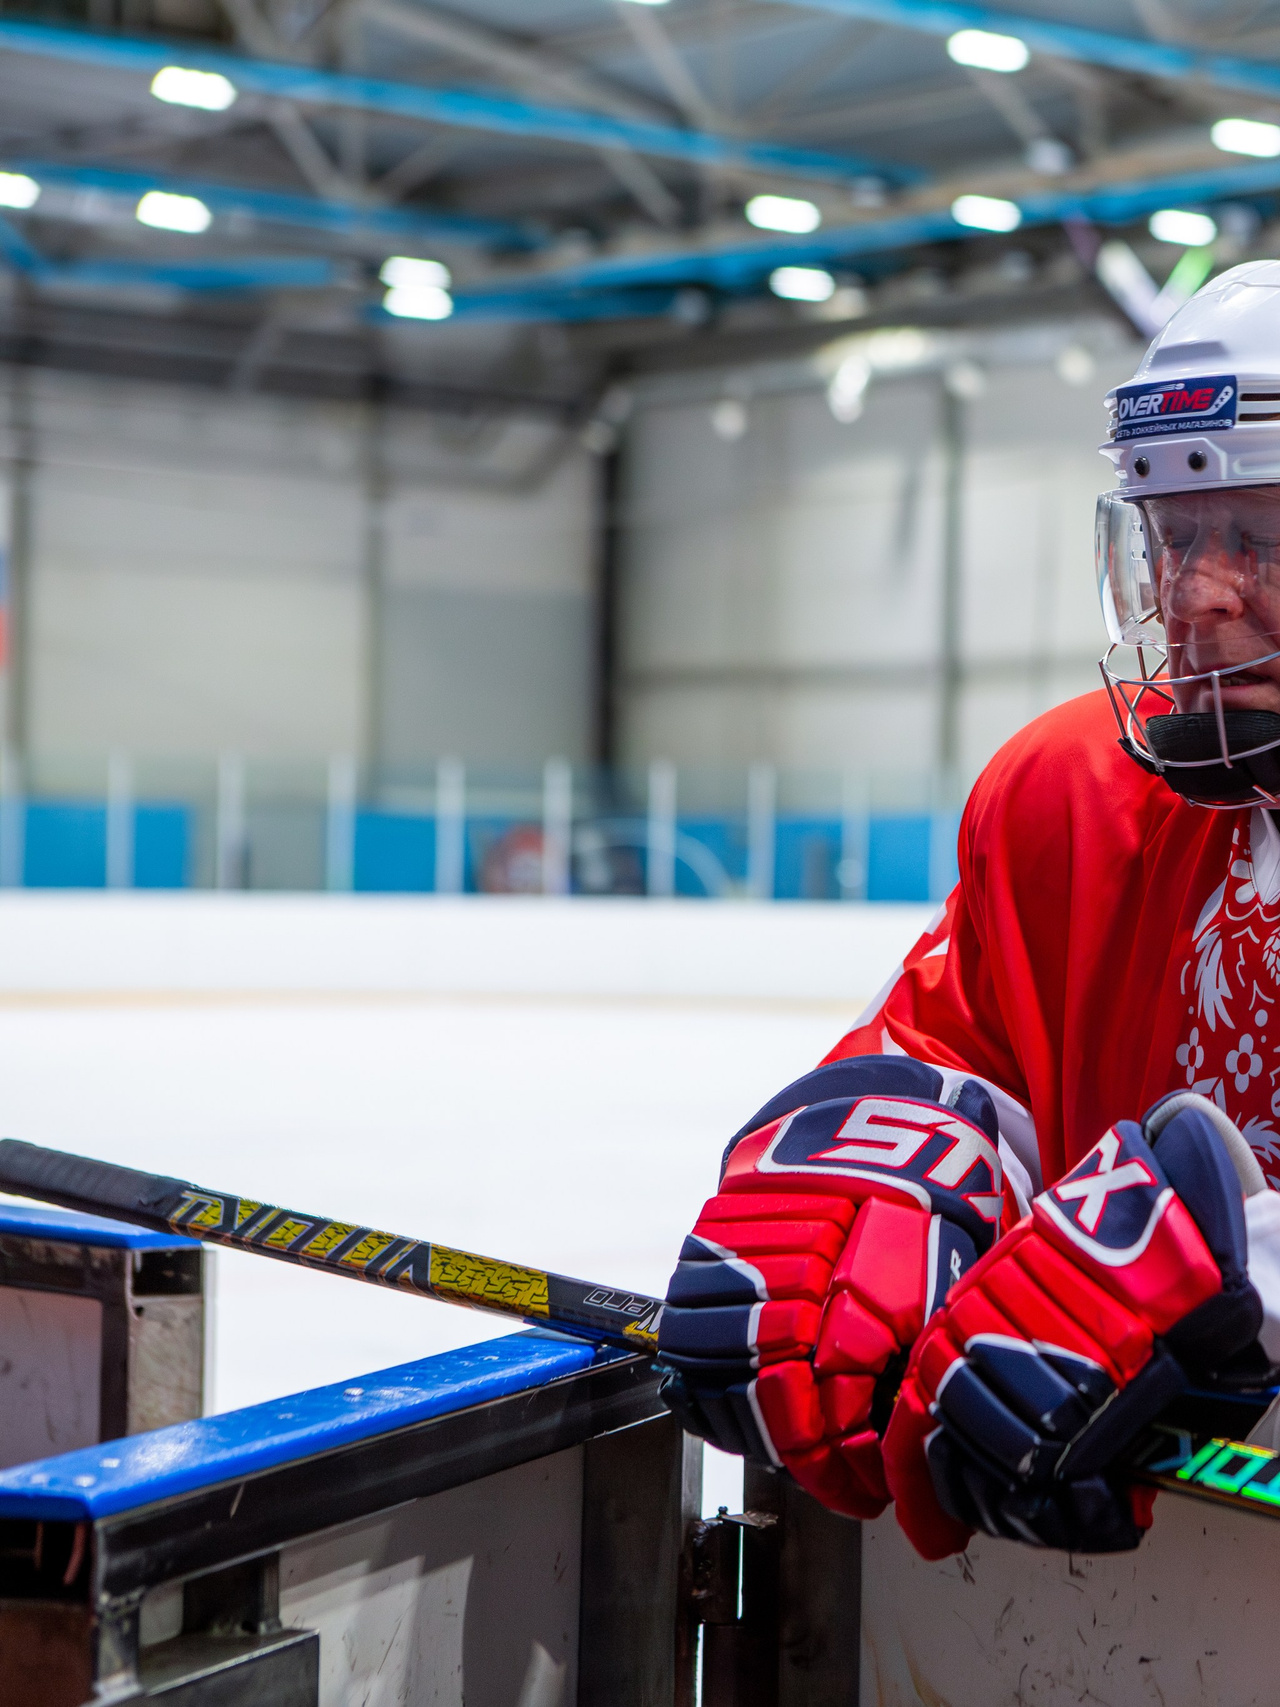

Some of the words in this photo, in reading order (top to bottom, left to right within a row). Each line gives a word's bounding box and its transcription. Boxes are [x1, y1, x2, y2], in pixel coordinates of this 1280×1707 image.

[1119, 388, 1215, 419] OVERTIME
[1131, 424, 1177, 436] ХОККЕЙНЫХ
[1178, 419, 1233, 430] МАГАЗИНОВ
